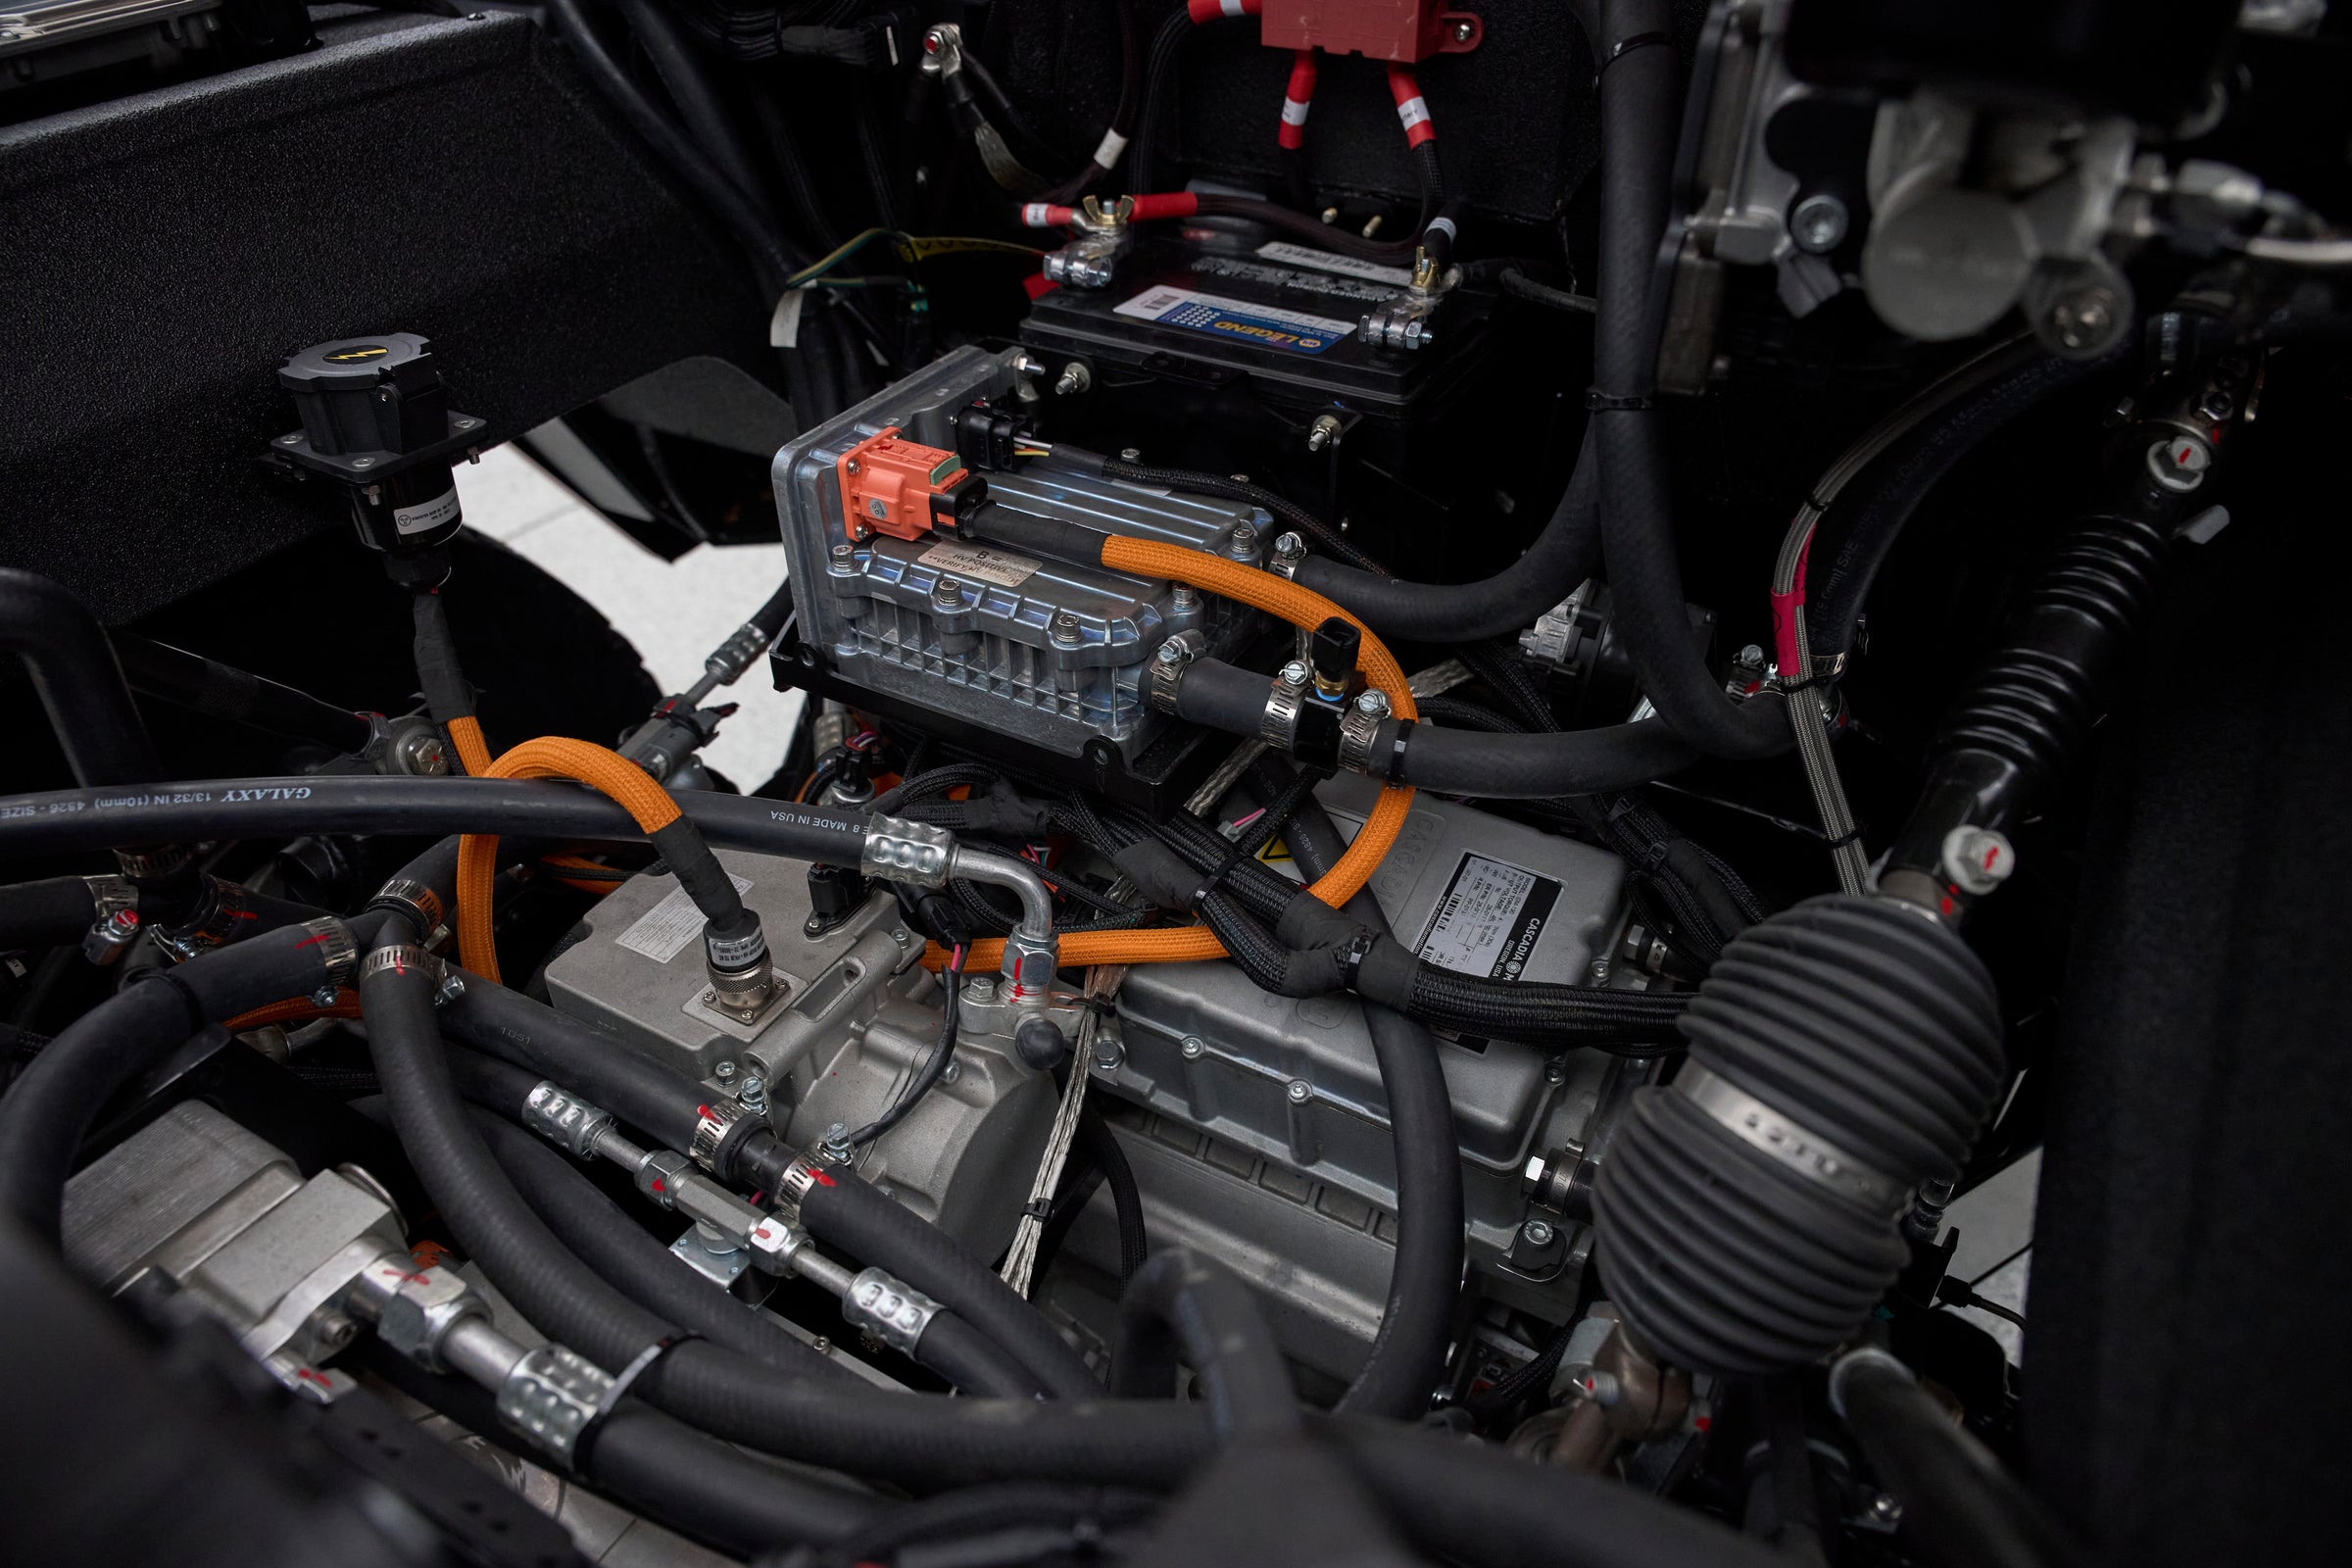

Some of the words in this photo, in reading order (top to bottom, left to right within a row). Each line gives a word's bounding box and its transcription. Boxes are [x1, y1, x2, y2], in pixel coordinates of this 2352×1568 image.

[1214, 320, 1300, 344] LEGEND
[976, 550, 990, 560] B
[953, 553, 967, 562] HV
[967, 557, 1010, 574] POSITIVE
[154, 795, 170, 806] IN
[173, 792, 212, 804] 13/32
[220, 786, 312, 803] GALAXY
[94, 796, 150, 809] (10mm)
[1, 806, 36, 819] SIZE
[770, 810, 795, 822] USA
[798, 814, 810, 825] IN
[812, 816, 847, 831] MADE
[852, 824, 860, 833] 8
[1519, 877, 1532, 895] MODEL:
[1502, 893, 1516, 916] TORQUE:
[1512, 917, 1541, 961] CASCADIA
[1493, 964, 1503, 977] USA
